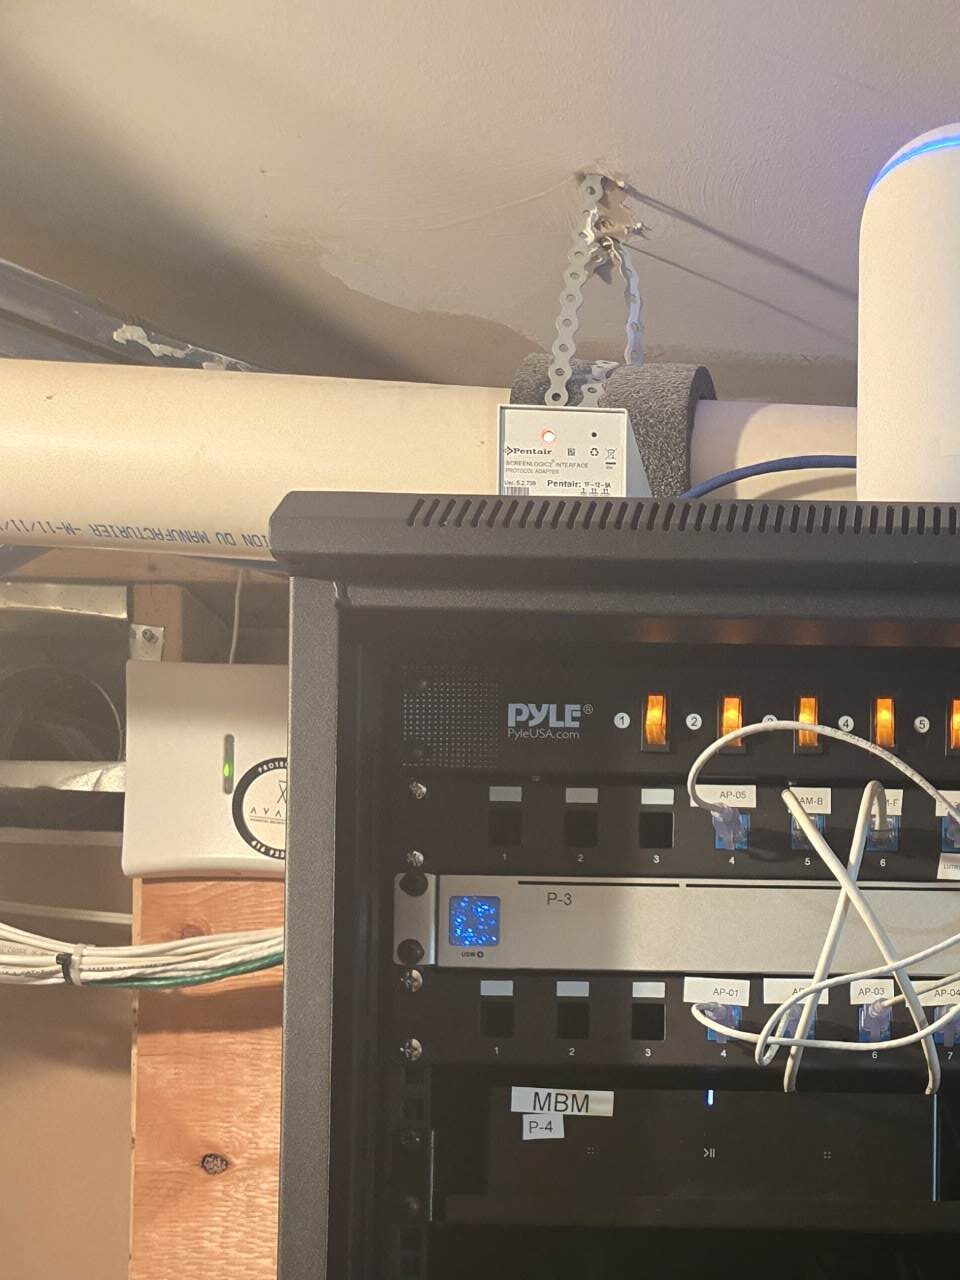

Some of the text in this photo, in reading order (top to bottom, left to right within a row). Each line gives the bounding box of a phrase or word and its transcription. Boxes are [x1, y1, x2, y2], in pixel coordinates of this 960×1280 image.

[513, 447, 553, 455] Pentair
[547, 480, 582, 488] Pentair:
[90, 523, 210, 544] MANUFACTURIER
[216, 533, 237, 545] DU
[619, 715, 626, 727] 1
[689, 715, 699, 728] 2
[841, 718, 851, 730] 4
[917, 718, 927, 731] 5
[508, 728, 581, 740] PyleUSA.com
[719, 790, 747, 800] AP-05
[577, 853, 584, 862] 2
[653, 855, 660, 863] 3
[728, 856, 735, 865] 4
[804, 857, 811, 866] 5
[880, 859, 886, 867] 6
[547, 892, 573, 906] P-3
[713, 987, 738, 997] AP-01
[858, 987, 885, 996] AP-03
[934, 988, 960, 997] AP-04
[569, 1048, 576, 1056] 2
[644, 1048, 652, 1057] 3
[720, 1050, 727, 1058] 4
[872, 1051, 878, 1059] 6
[947, 1052, 954, 1060] 7
[533, 1091, 590, 1113] MBM
[529, 1120, 553, 1133] P-4
